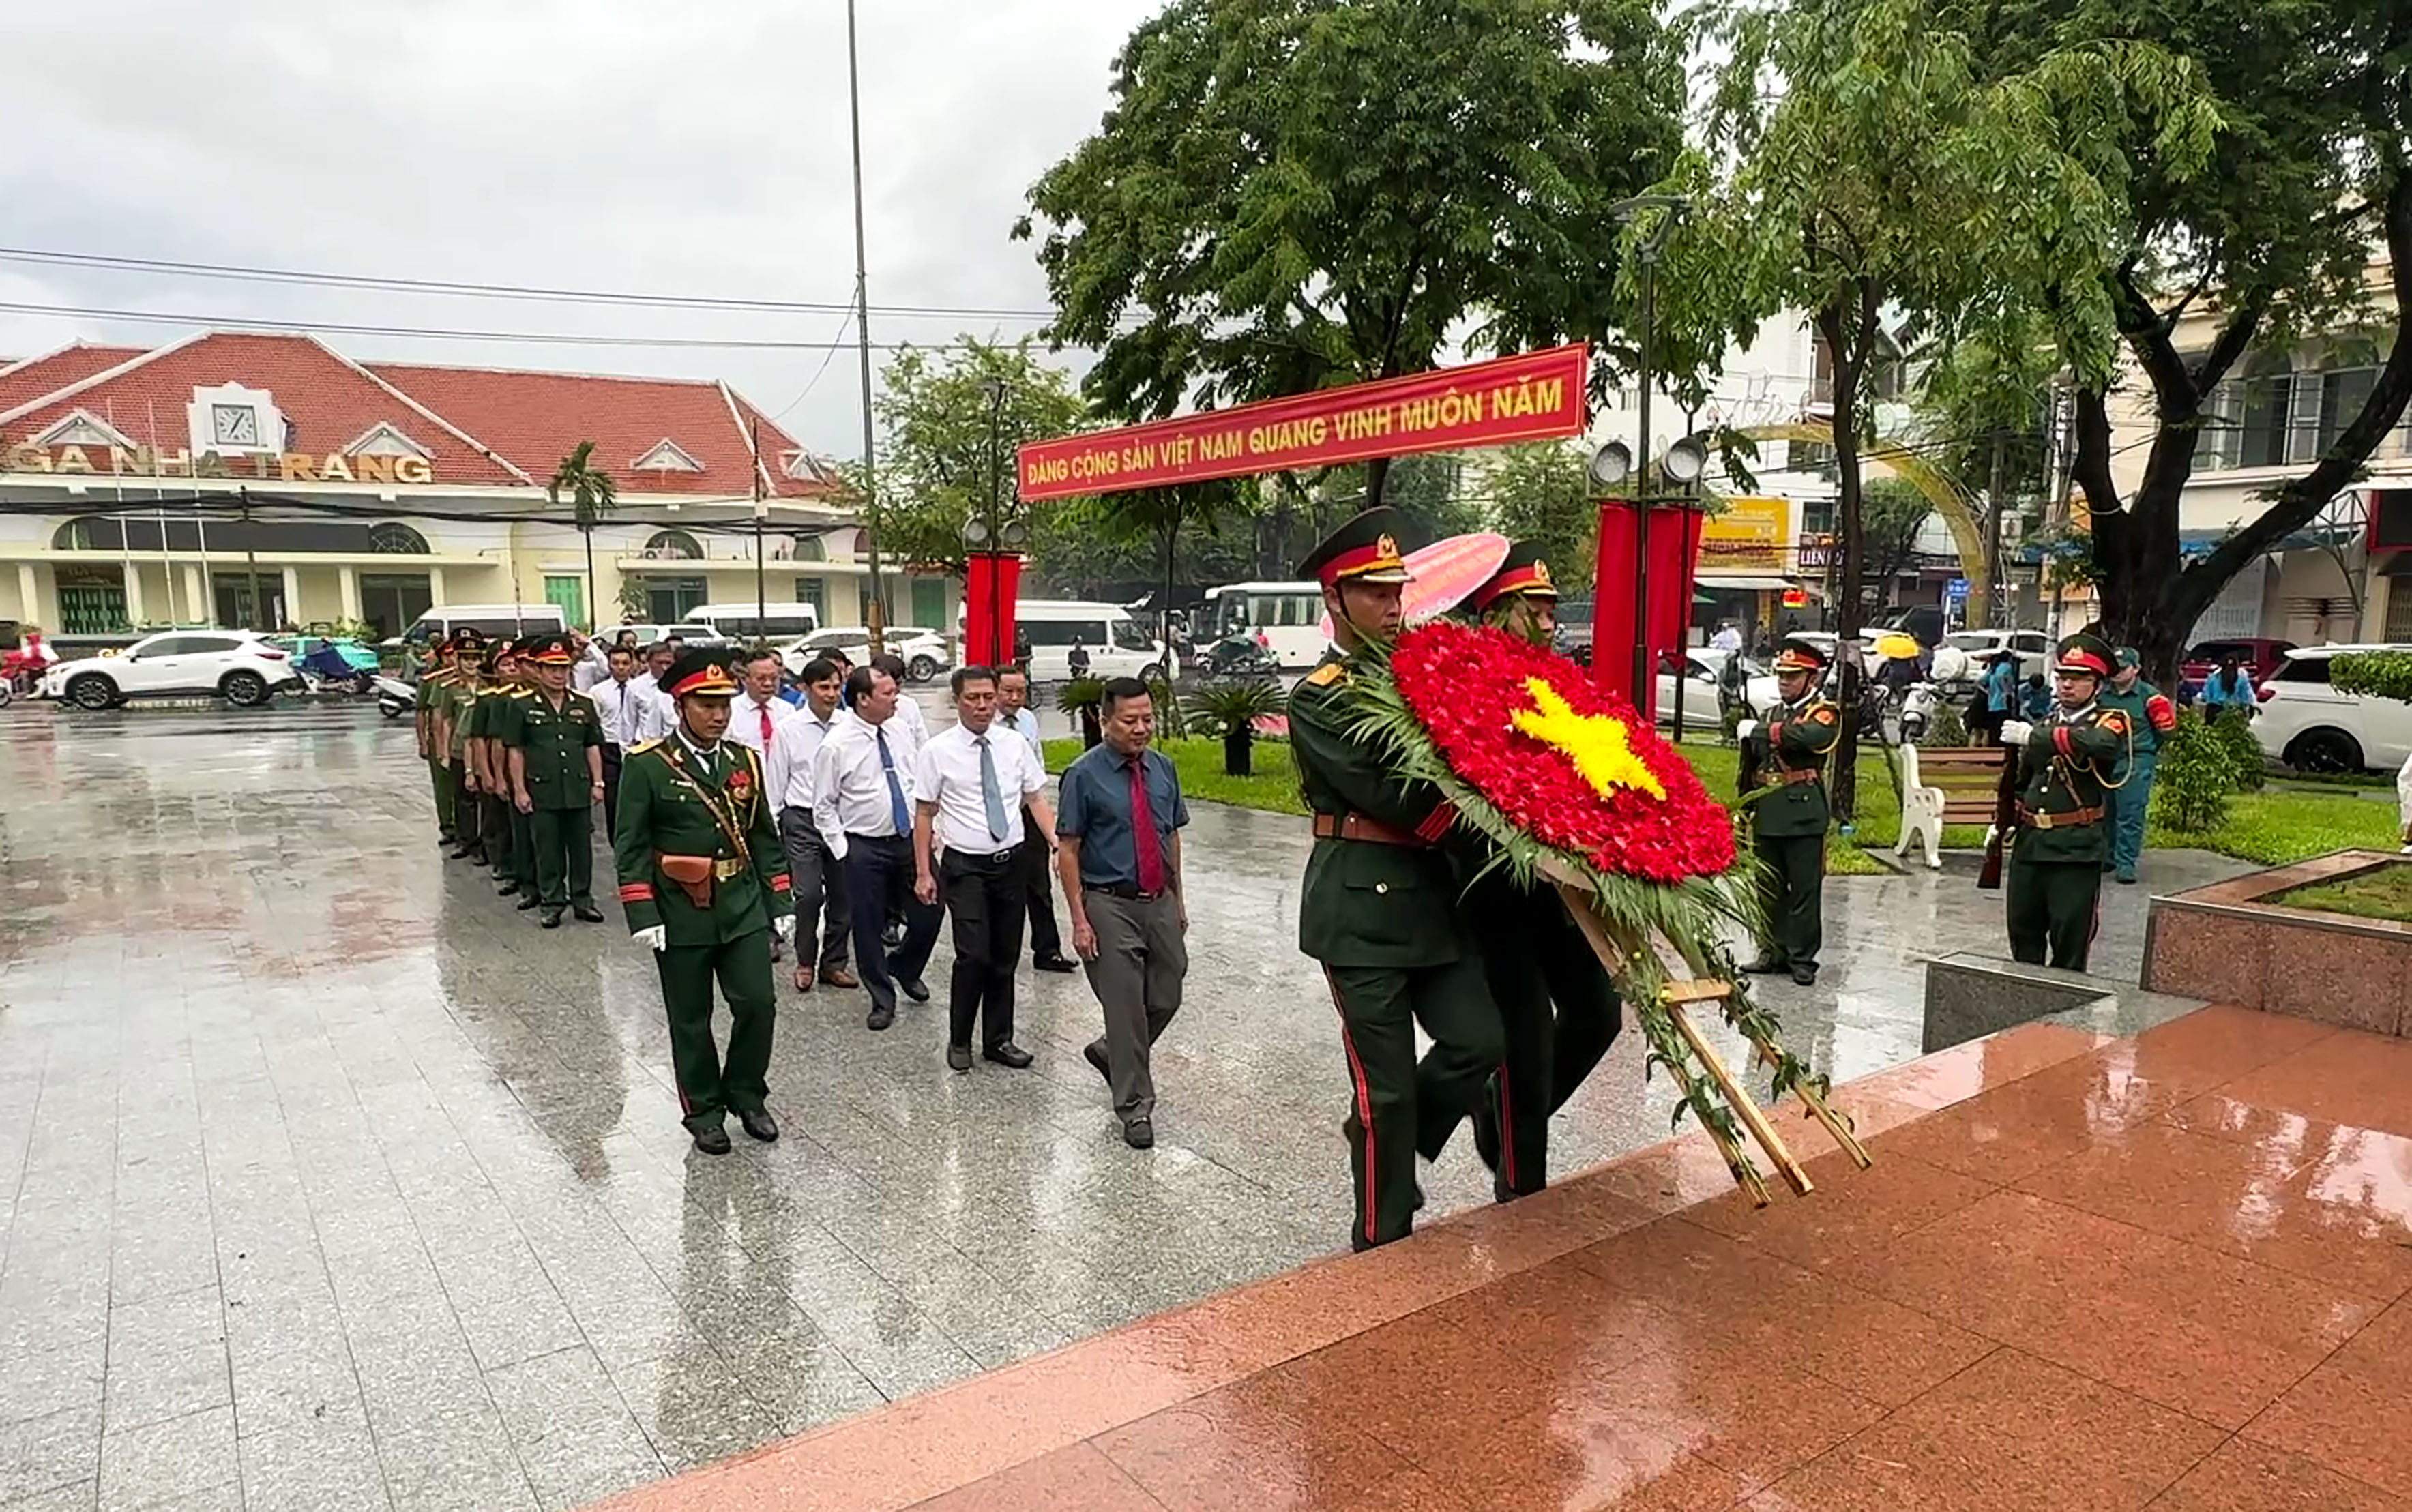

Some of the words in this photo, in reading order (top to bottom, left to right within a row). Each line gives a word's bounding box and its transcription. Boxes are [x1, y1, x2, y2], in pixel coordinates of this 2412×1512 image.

[5, 443, 95, 473] GA
[110, 444, 232, 477] NHA
[244, 451, 434, 484] TRANG
[1028, 454, 1068, 486] ĐẢNG
[1072, 449, 1119, 484] CỘNG
[1122, 438, 1156, 472] SẢN
[1160, 434, 1194, 472] VIỆT
[1199, 430, 1242, 461] NAM
[1249, 417, 1327, 456] QUANG
[1334, 406, 1392, 441] VINH
[1400, 386, 1482, 432] MUÔN
[1492, 375, 1563, 419] NĂM
